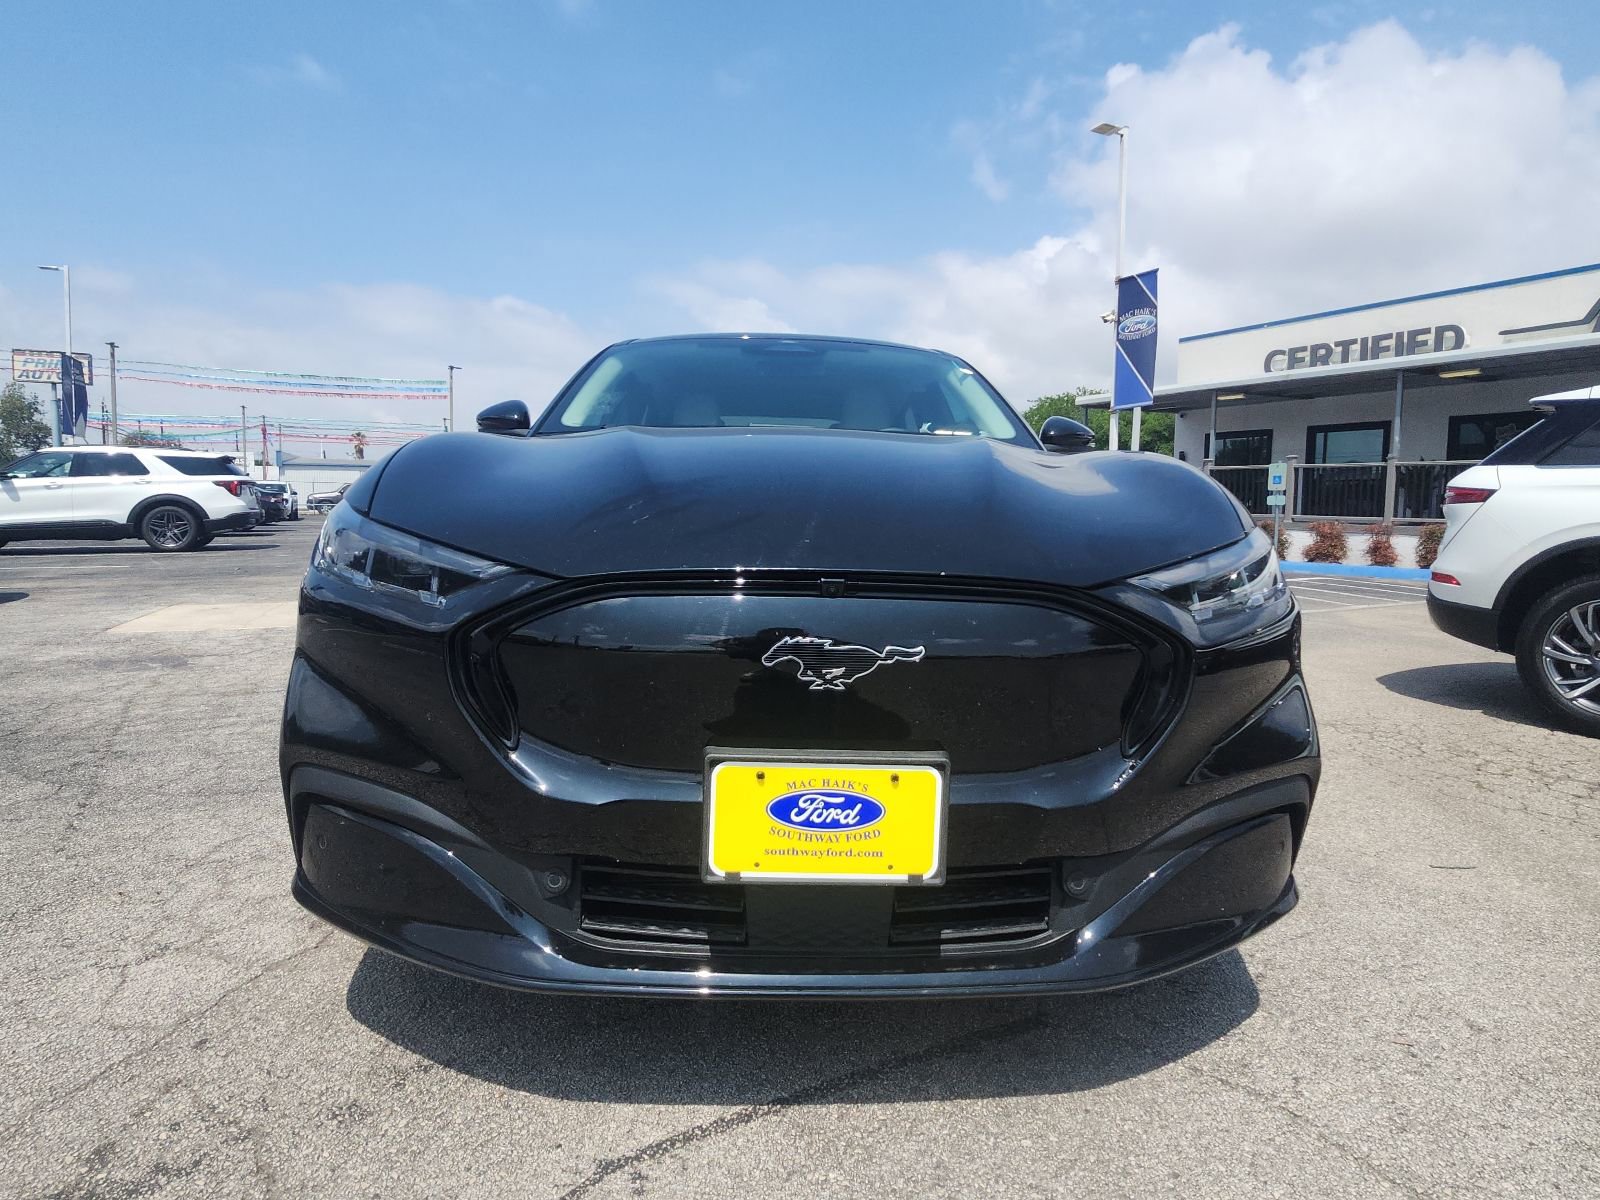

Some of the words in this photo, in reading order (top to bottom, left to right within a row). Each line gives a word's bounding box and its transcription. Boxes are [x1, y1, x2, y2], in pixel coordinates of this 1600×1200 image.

[1119, 310, 1133, 322] MAC
[1134, 307, 1156, 317] HAIK'S
[1124, 319, 1149, 333] Ford
[1264, 324, 1467, 374] CERTIFIED
[786, 779, 816, 791] MAC
[822, 778, 869, 792] HAIK'S
[790, 794, 862, 825] Ford
[768, 826, 841, 843] SOUTHWAY
[845, 828, 881, 843] FORD
[764, 847, 884, 859] southwayford.com
